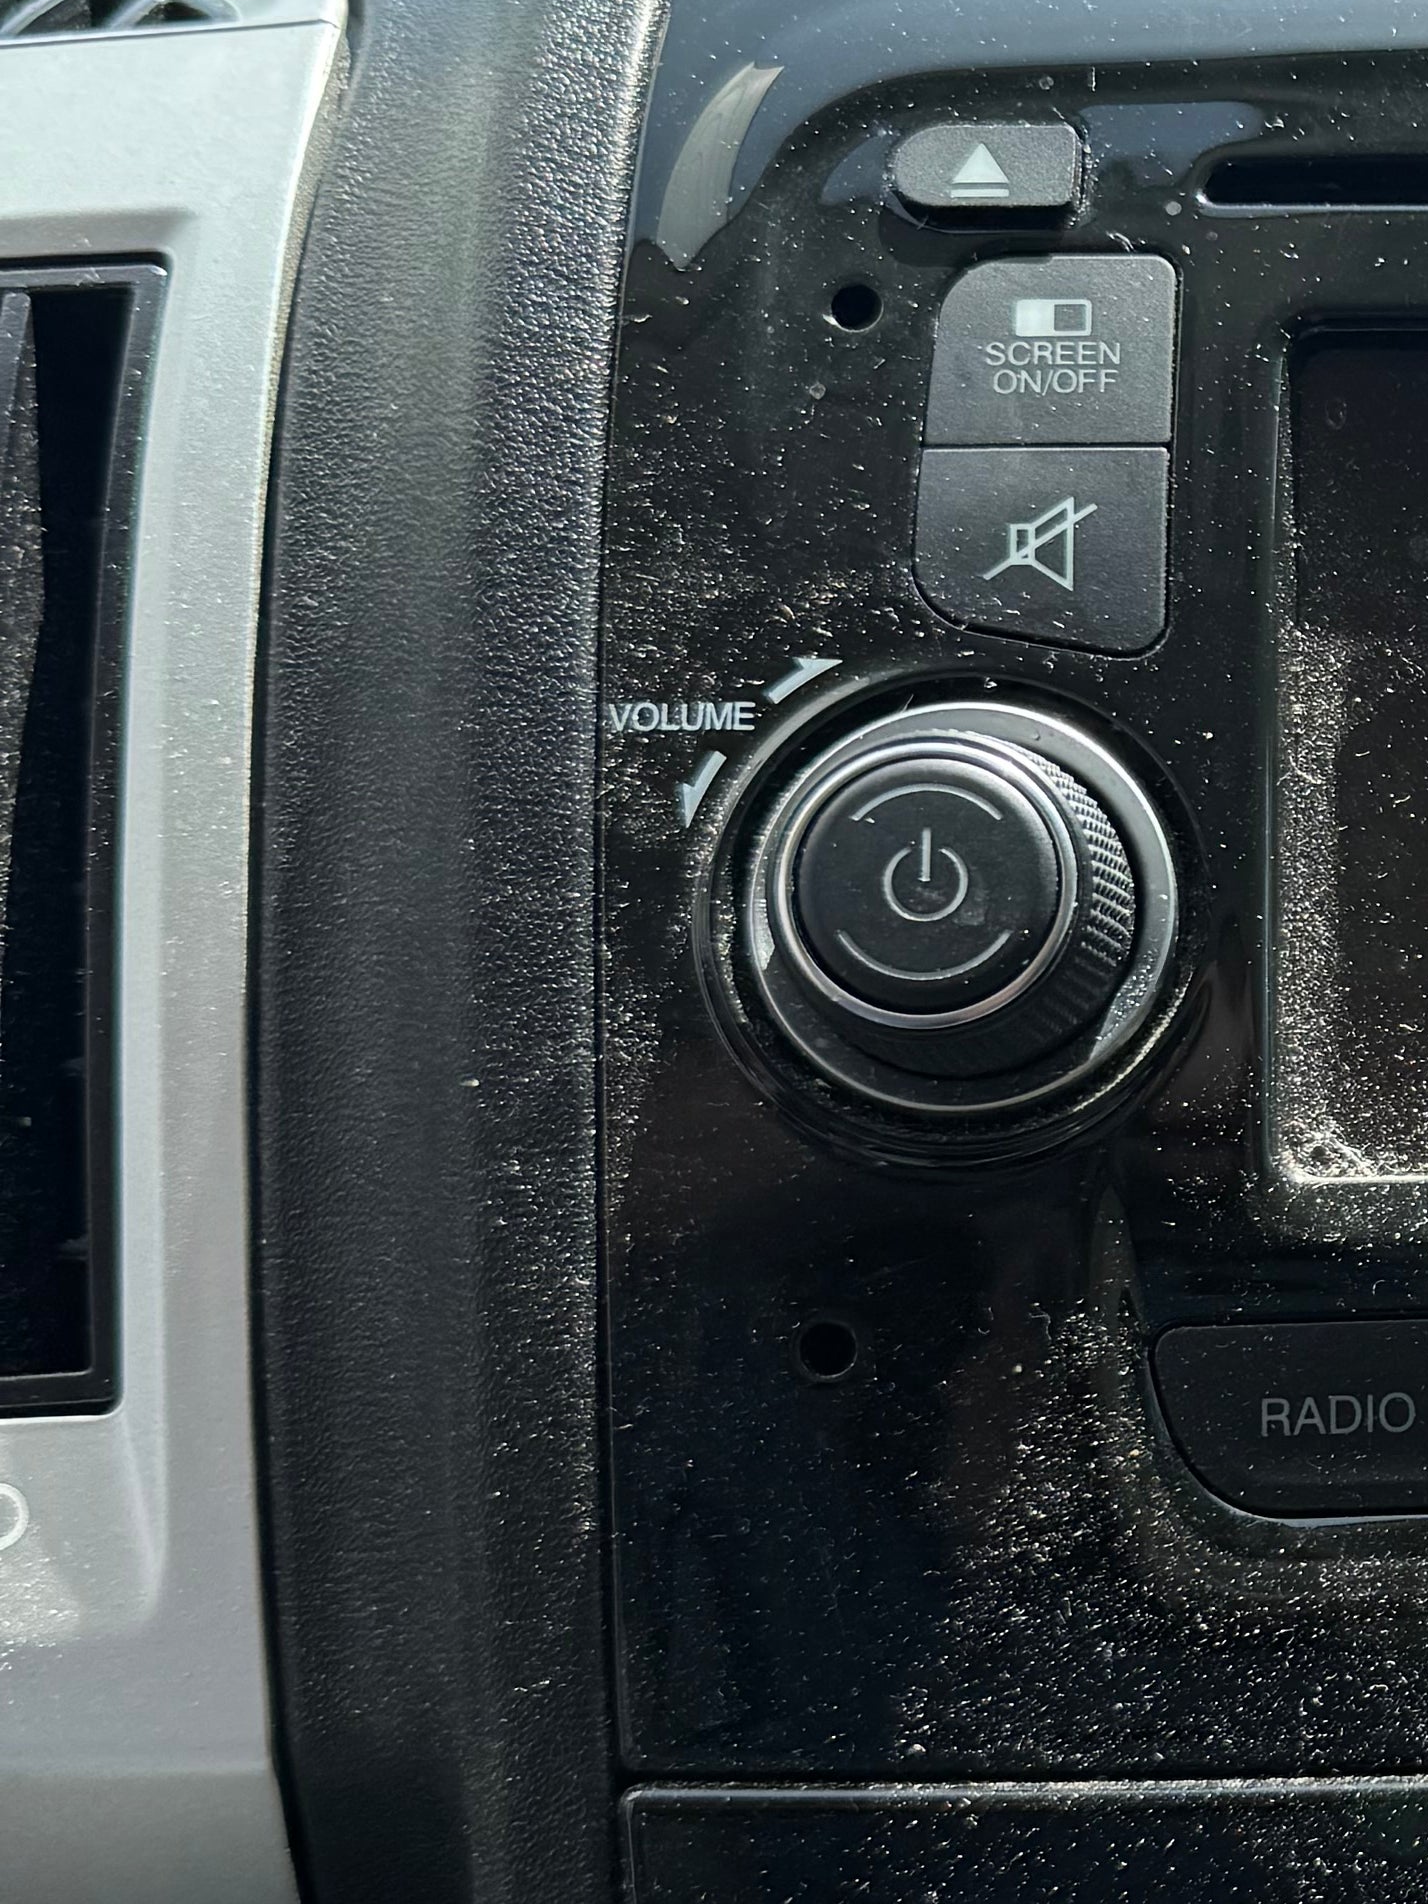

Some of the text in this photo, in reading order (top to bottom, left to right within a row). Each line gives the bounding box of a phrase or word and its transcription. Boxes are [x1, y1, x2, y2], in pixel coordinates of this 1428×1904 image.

[985, 341, 1121, 366] SCREEN
[992, 370, 1118, 394] ON/OFF
[608, 702, 756, 732] VOLUME
[1260, 1391, 1417, 1438] RADIO
